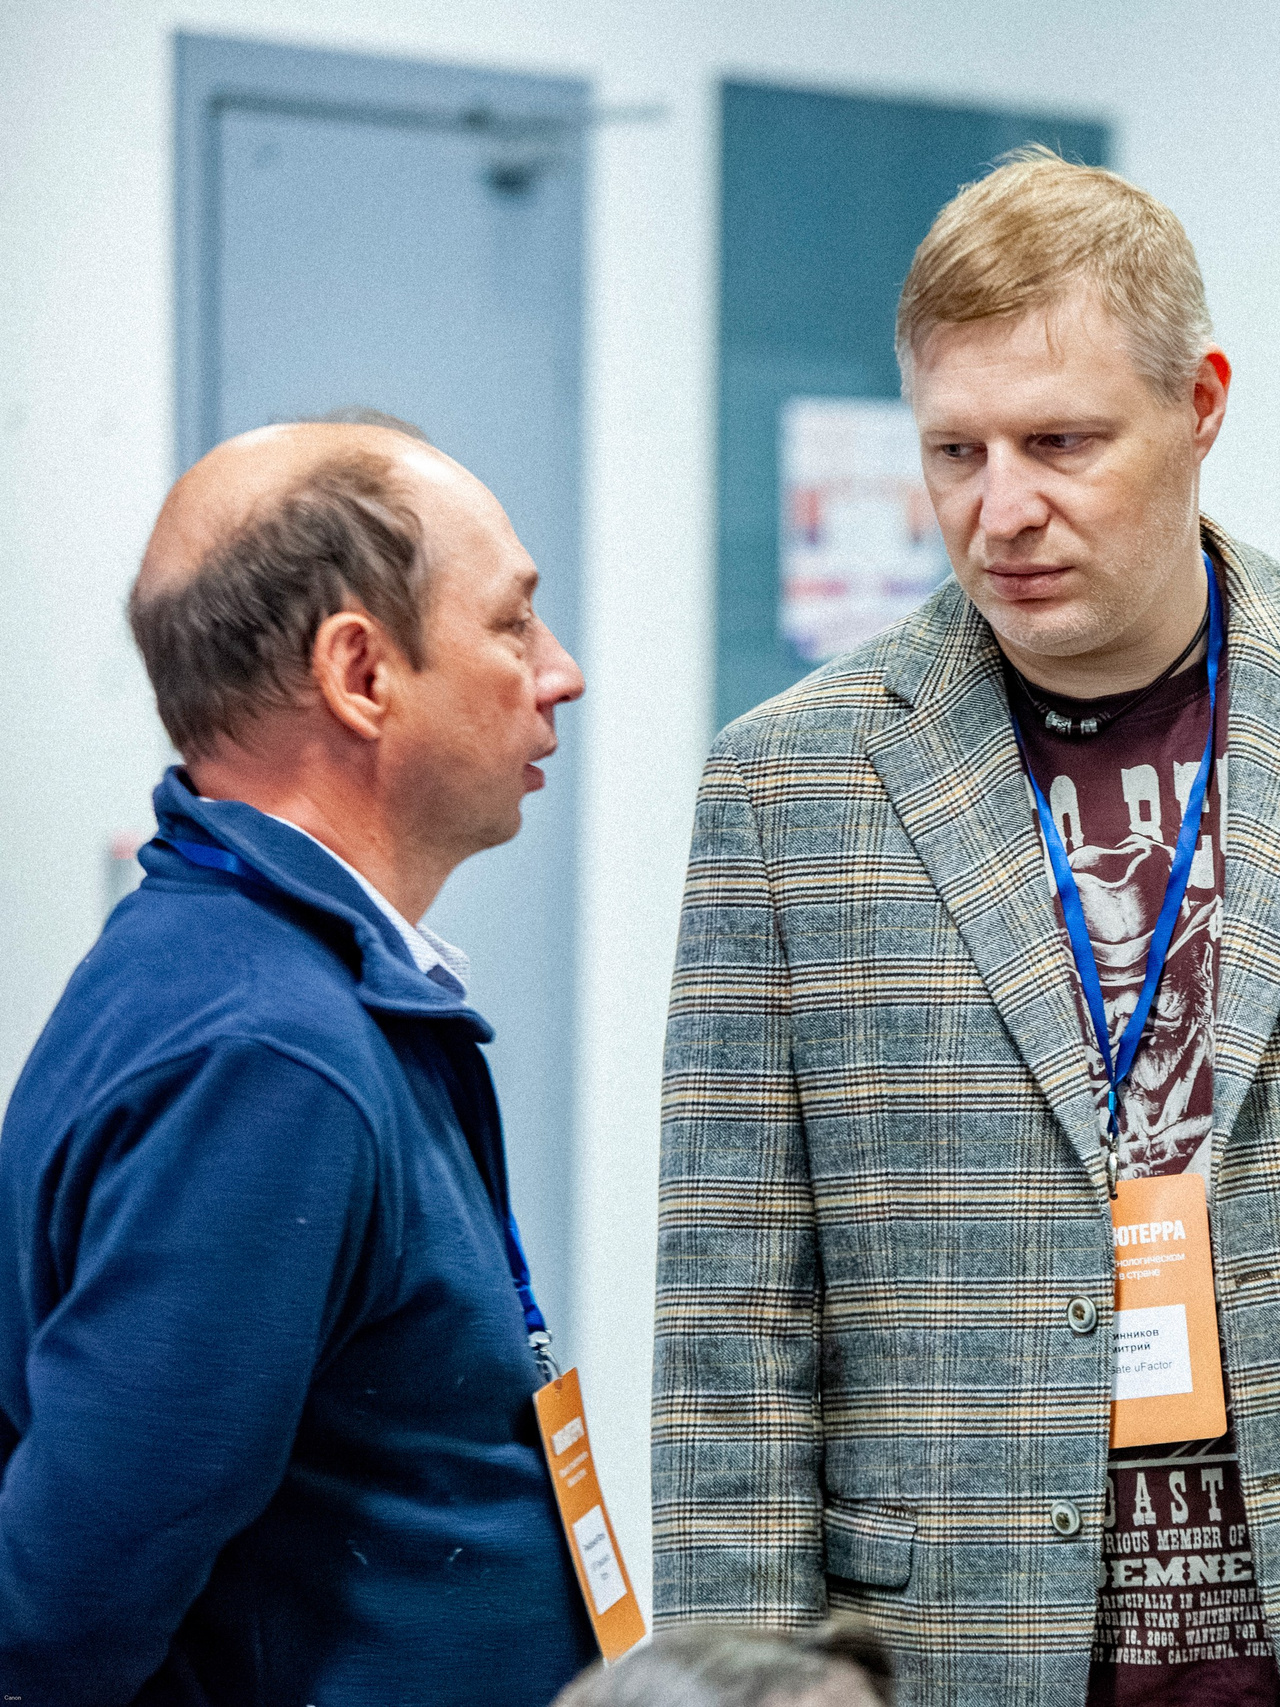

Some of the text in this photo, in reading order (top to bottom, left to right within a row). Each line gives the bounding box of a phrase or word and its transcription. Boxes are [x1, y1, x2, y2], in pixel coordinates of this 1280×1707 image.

[1134, 1361, 1172, 1373] uFactor
[1156, 1526, 1222, 1551] MEMBER
[1229, 1524, 1246, 1547] OF
[1180, 1593, 1193, 1609] IN
[1145, 1611, 1180, 1629] STATE
[1185, 1625, 1230, 1646] WANTED
[1235, 1622, 1257, 1639] FOR
